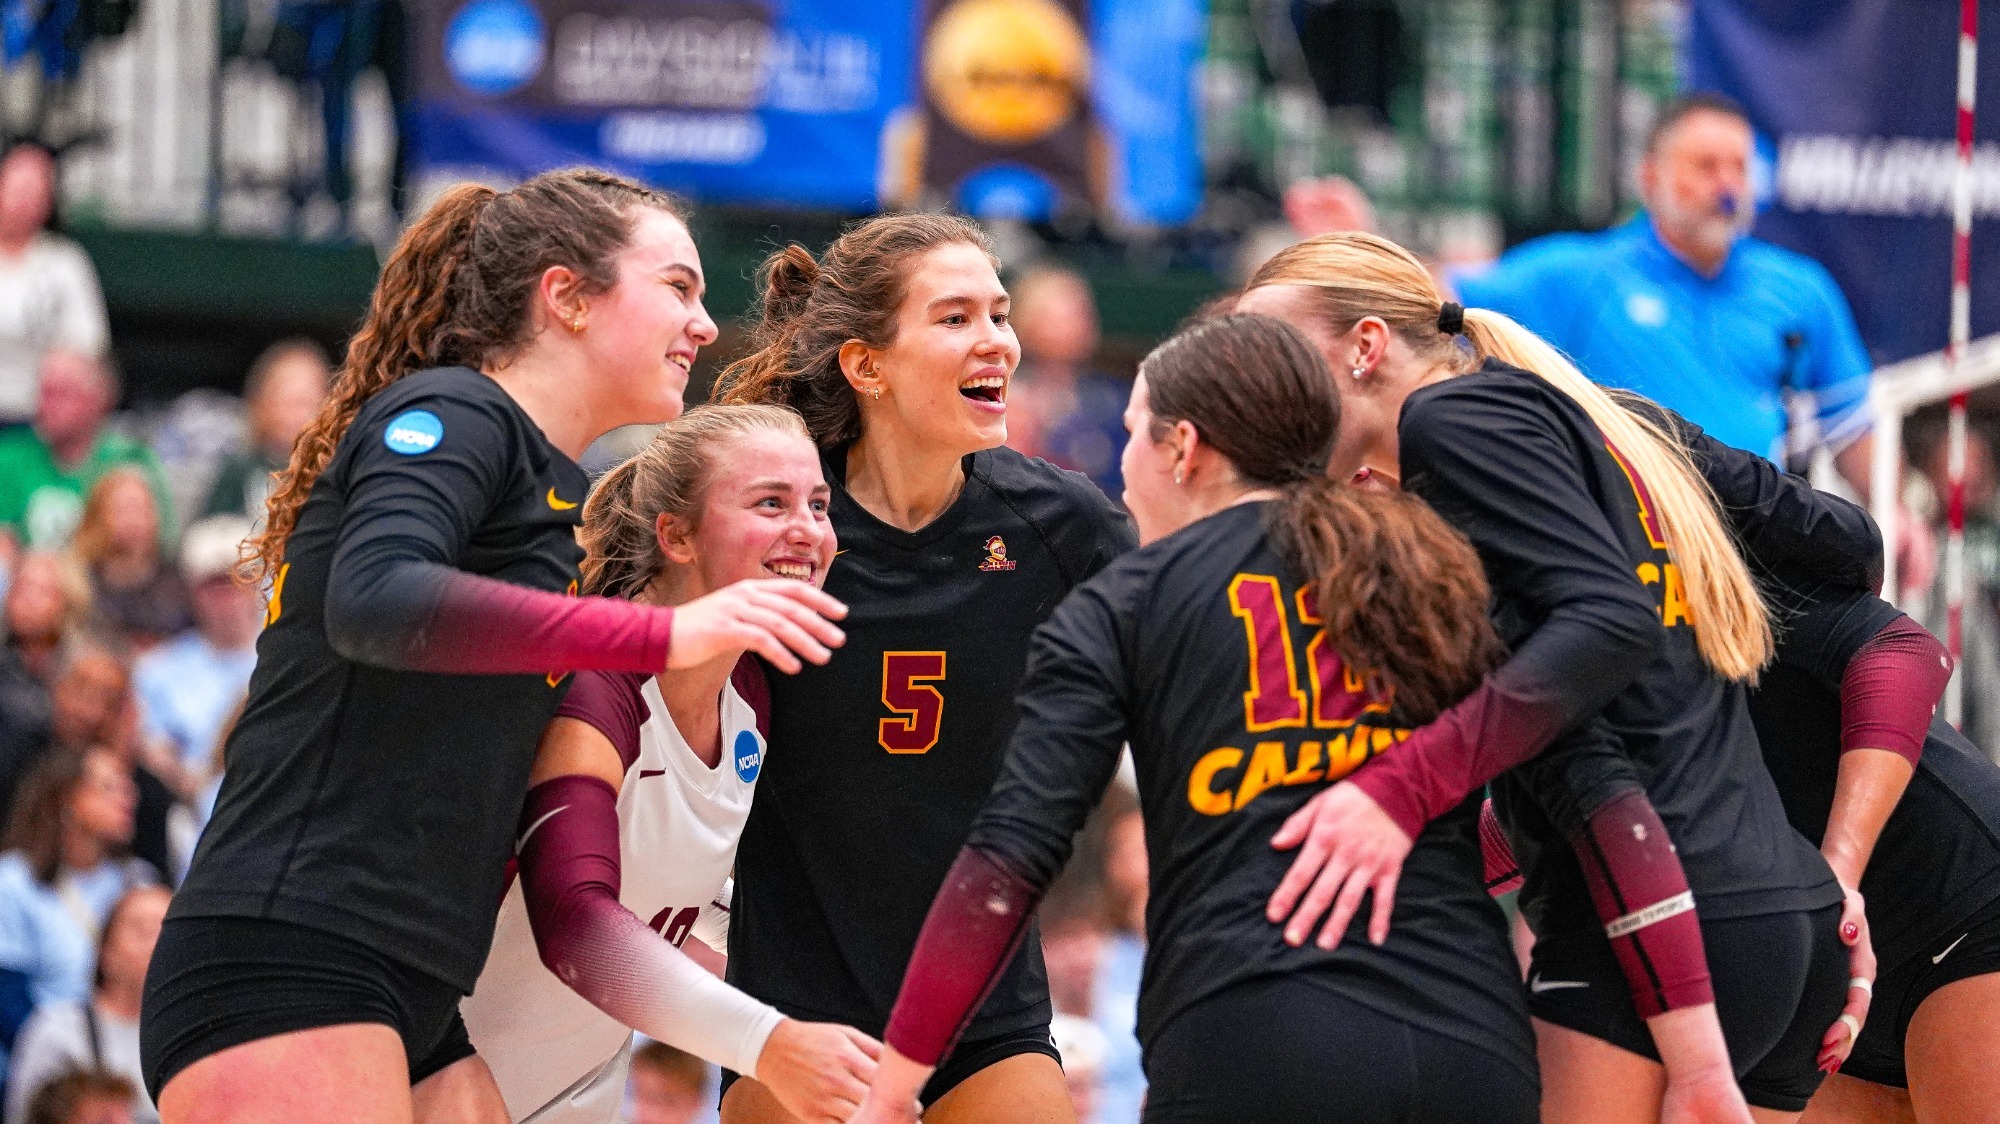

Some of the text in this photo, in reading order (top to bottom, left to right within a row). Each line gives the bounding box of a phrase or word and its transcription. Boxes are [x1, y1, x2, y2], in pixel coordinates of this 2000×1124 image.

[390, 428, 436, 448] NCAA
[878, 651, 947, 754] 5
[738, 753, 759, 771] NCAA
[1187, 725, 1411, 816] CALV
